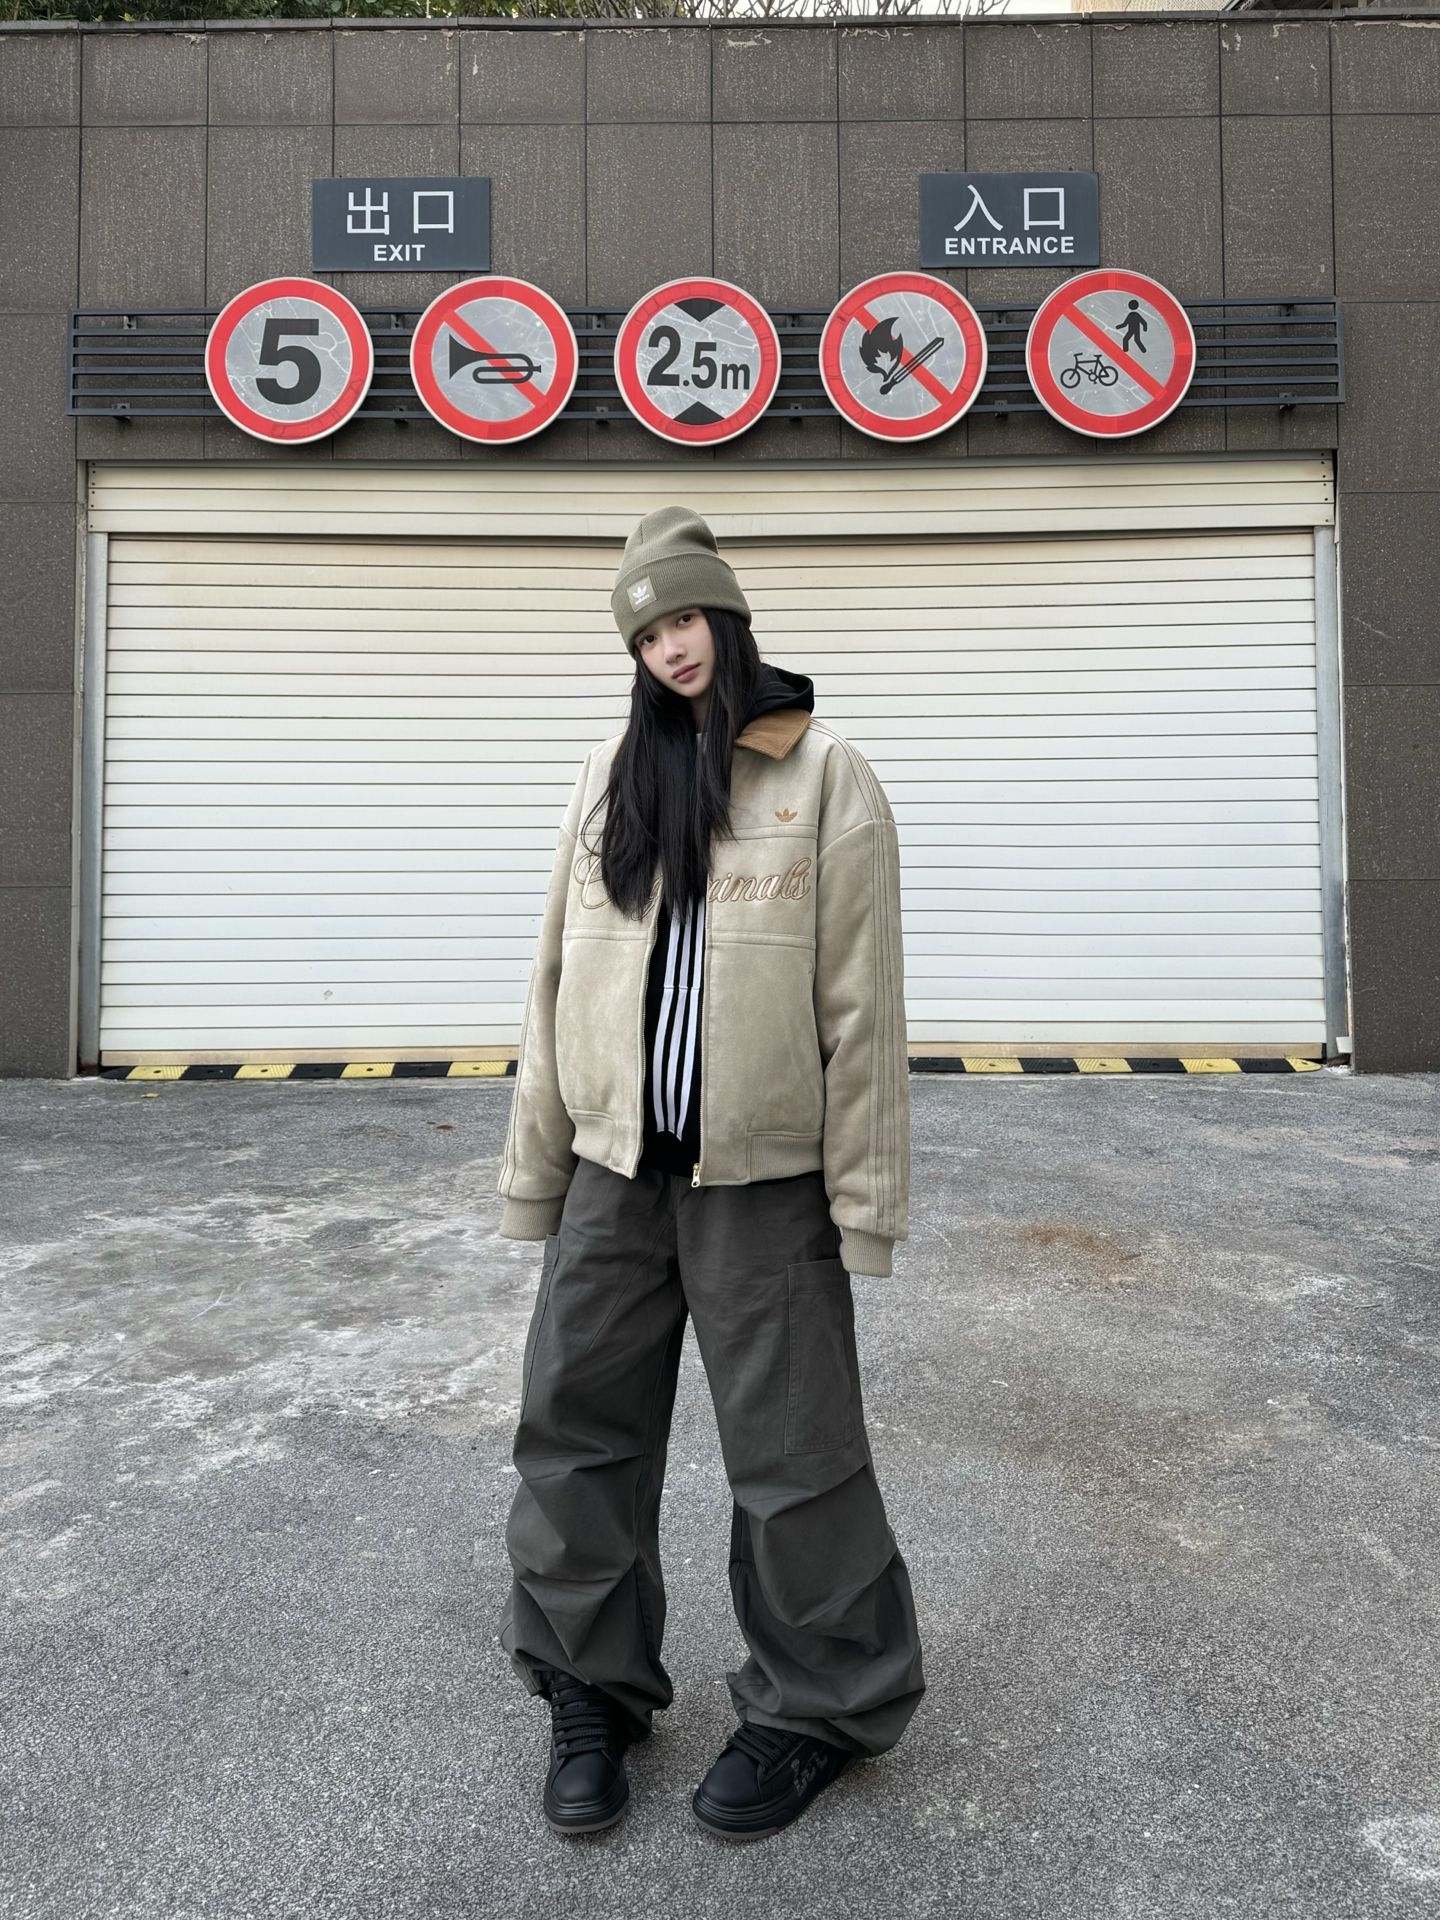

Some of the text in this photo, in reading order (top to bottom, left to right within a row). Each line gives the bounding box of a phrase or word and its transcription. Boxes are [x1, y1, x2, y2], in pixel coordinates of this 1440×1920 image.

[347, 188, 453, 235] 出口
[954, 184, 1064, 232] 入口
[374, 245, 425, 262] EXIT
[945, 237, 1075, 255] ENTRANCE
[256, 319, 322, 406] 5
[647, 325, 750, 390] 2.5m
